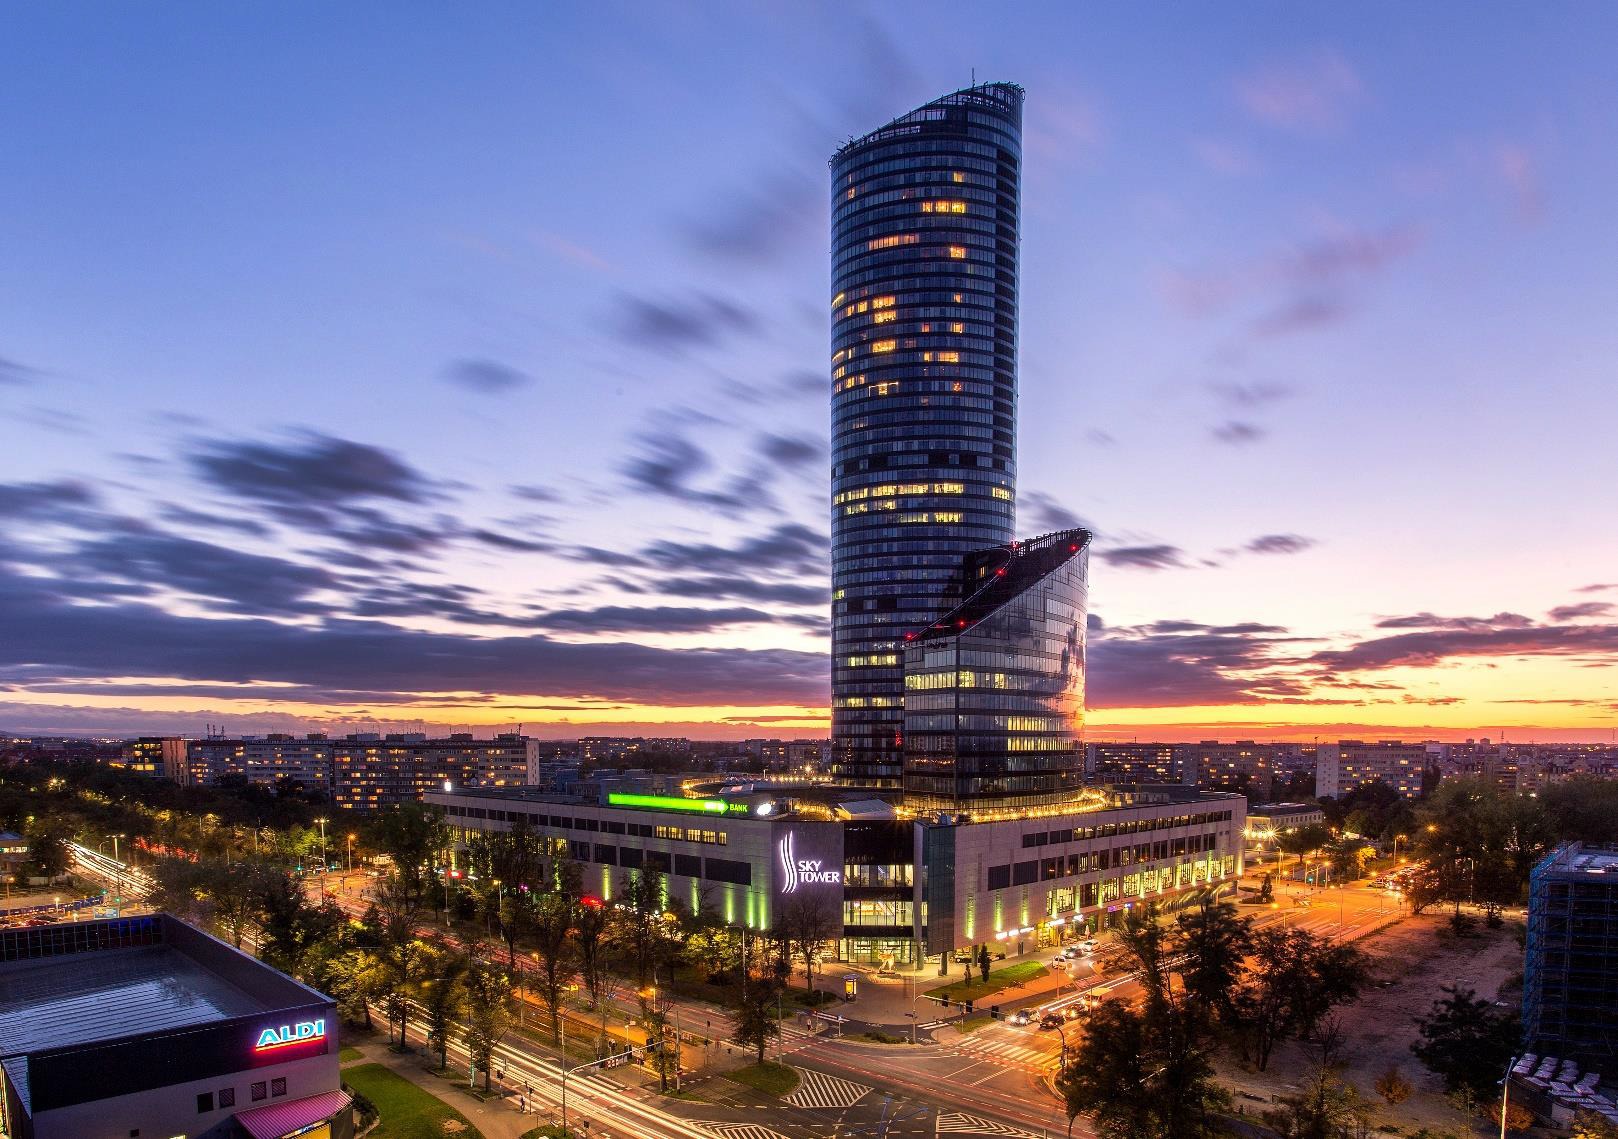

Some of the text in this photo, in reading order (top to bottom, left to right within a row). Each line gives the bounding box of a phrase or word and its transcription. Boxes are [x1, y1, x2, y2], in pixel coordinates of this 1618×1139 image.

[729, 803, 748, 813] BANK
[798, 860, 821, 872] SKY
[798, 871, 840, 883] TOWER
[256, 1019, 324, 1047] ALDI
